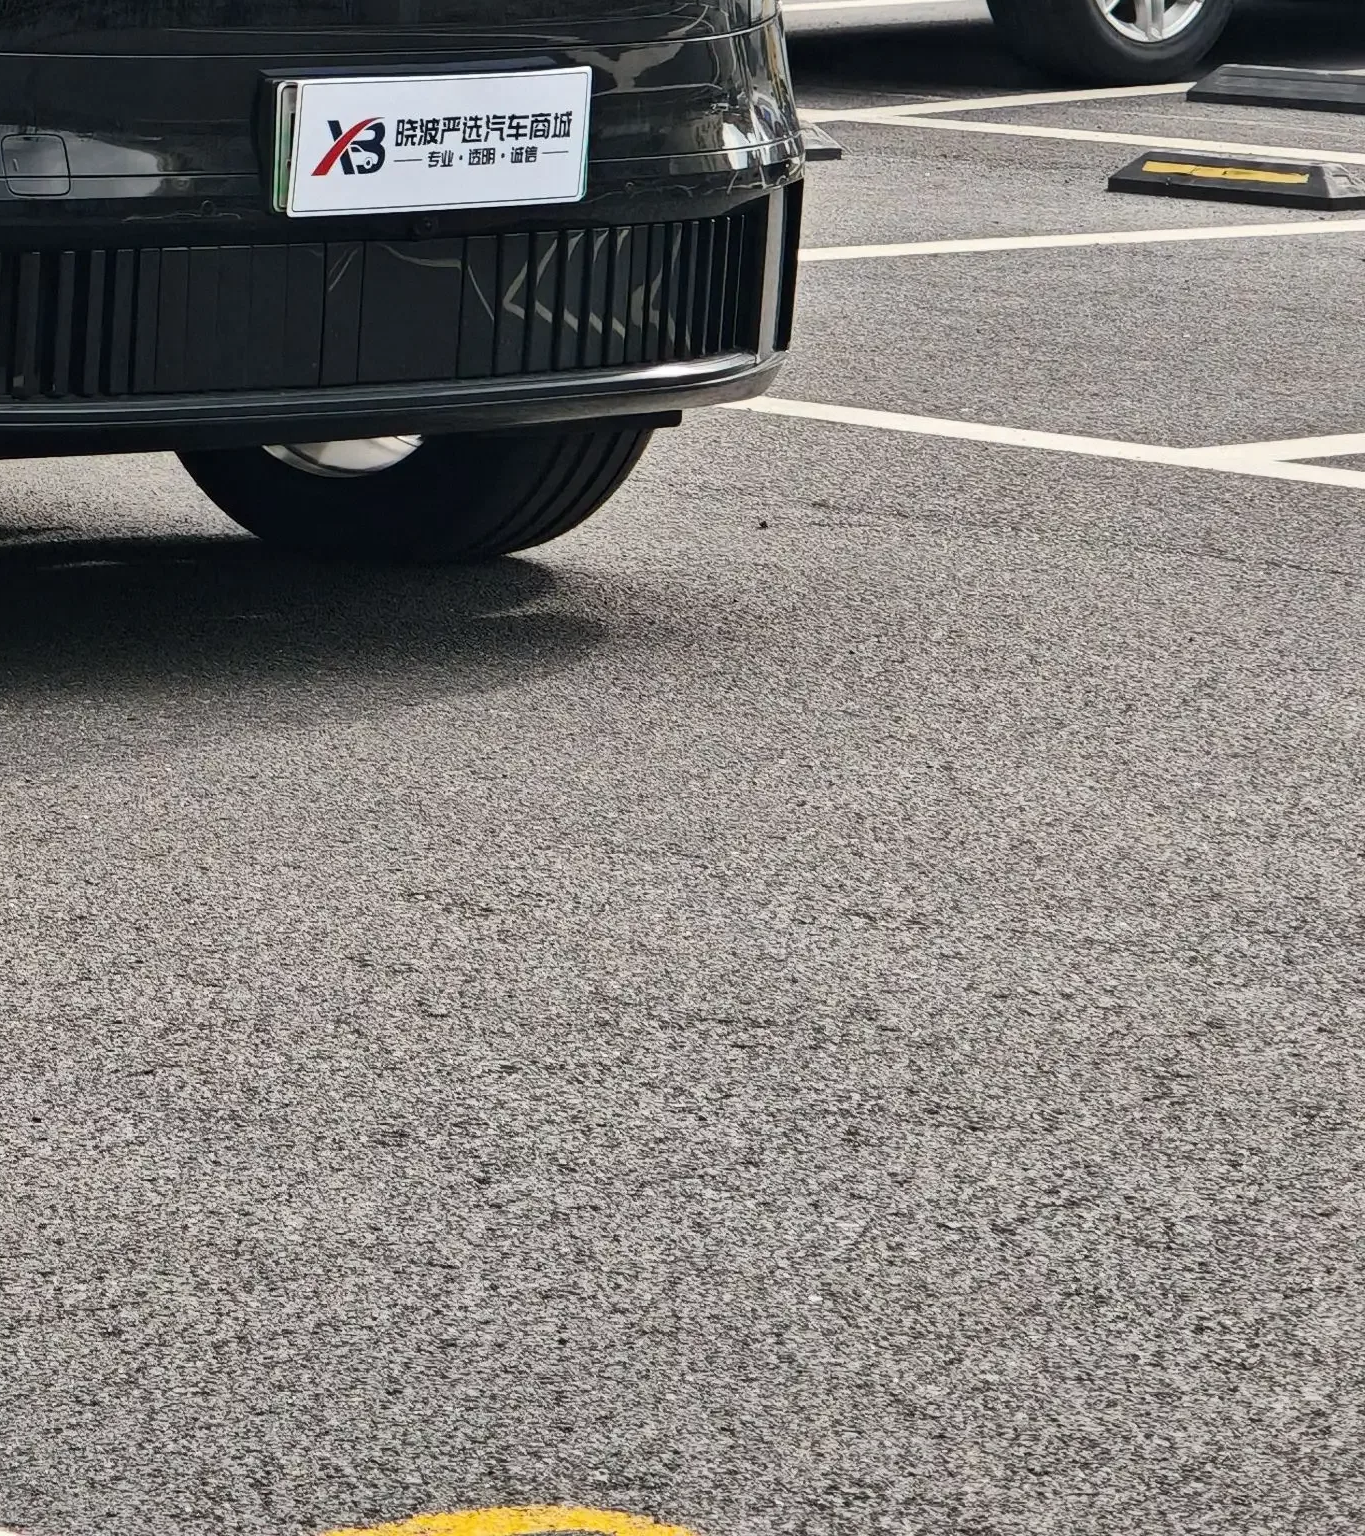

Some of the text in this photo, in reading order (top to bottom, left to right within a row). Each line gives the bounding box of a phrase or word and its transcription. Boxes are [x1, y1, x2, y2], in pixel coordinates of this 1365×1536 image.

[394, 110, 573, 147] 晓波严选汽车商城
